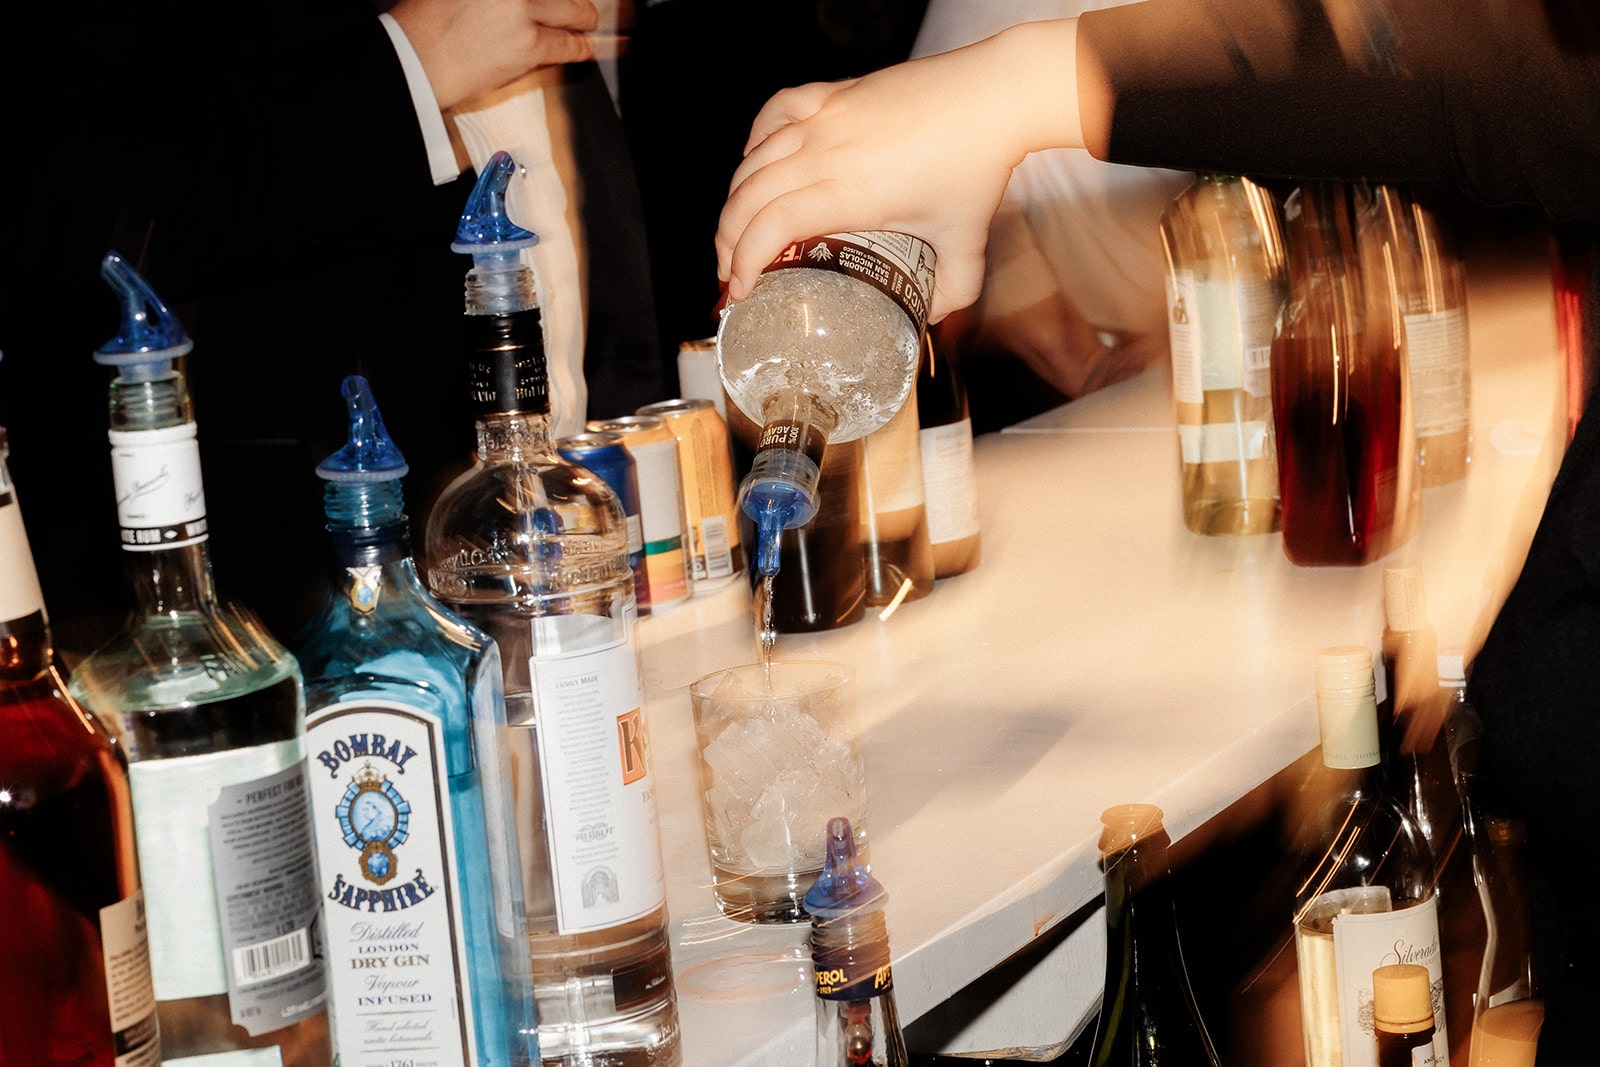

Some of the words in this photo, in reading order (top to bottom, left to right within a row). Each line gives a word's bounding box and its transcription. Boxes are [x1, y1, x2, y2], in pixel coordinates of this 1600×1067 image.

[839, 251, 875, 272] NICOLAS
[839, 258, 888, 286] DESTILADORA
[875, 264, 890, 279] SAN
[760, 434, 787, 448] PURO
[580, 675, 599, 685] MADE
[317, 733, 418, 779] BOMBAY
[327, 868, 435, 912] SAPPHIRE
[349, 921, 425, 942] Distilled
[358, 943, 420, 954] LONDON
[350, 956, 389, 970] DRY
[393, 954, 430, 967] GIN
[364, 974, 420, 994] Vapour
[815, 968, 848, 985] PEROL
[357, 993, 432, 1006] INFUSED
